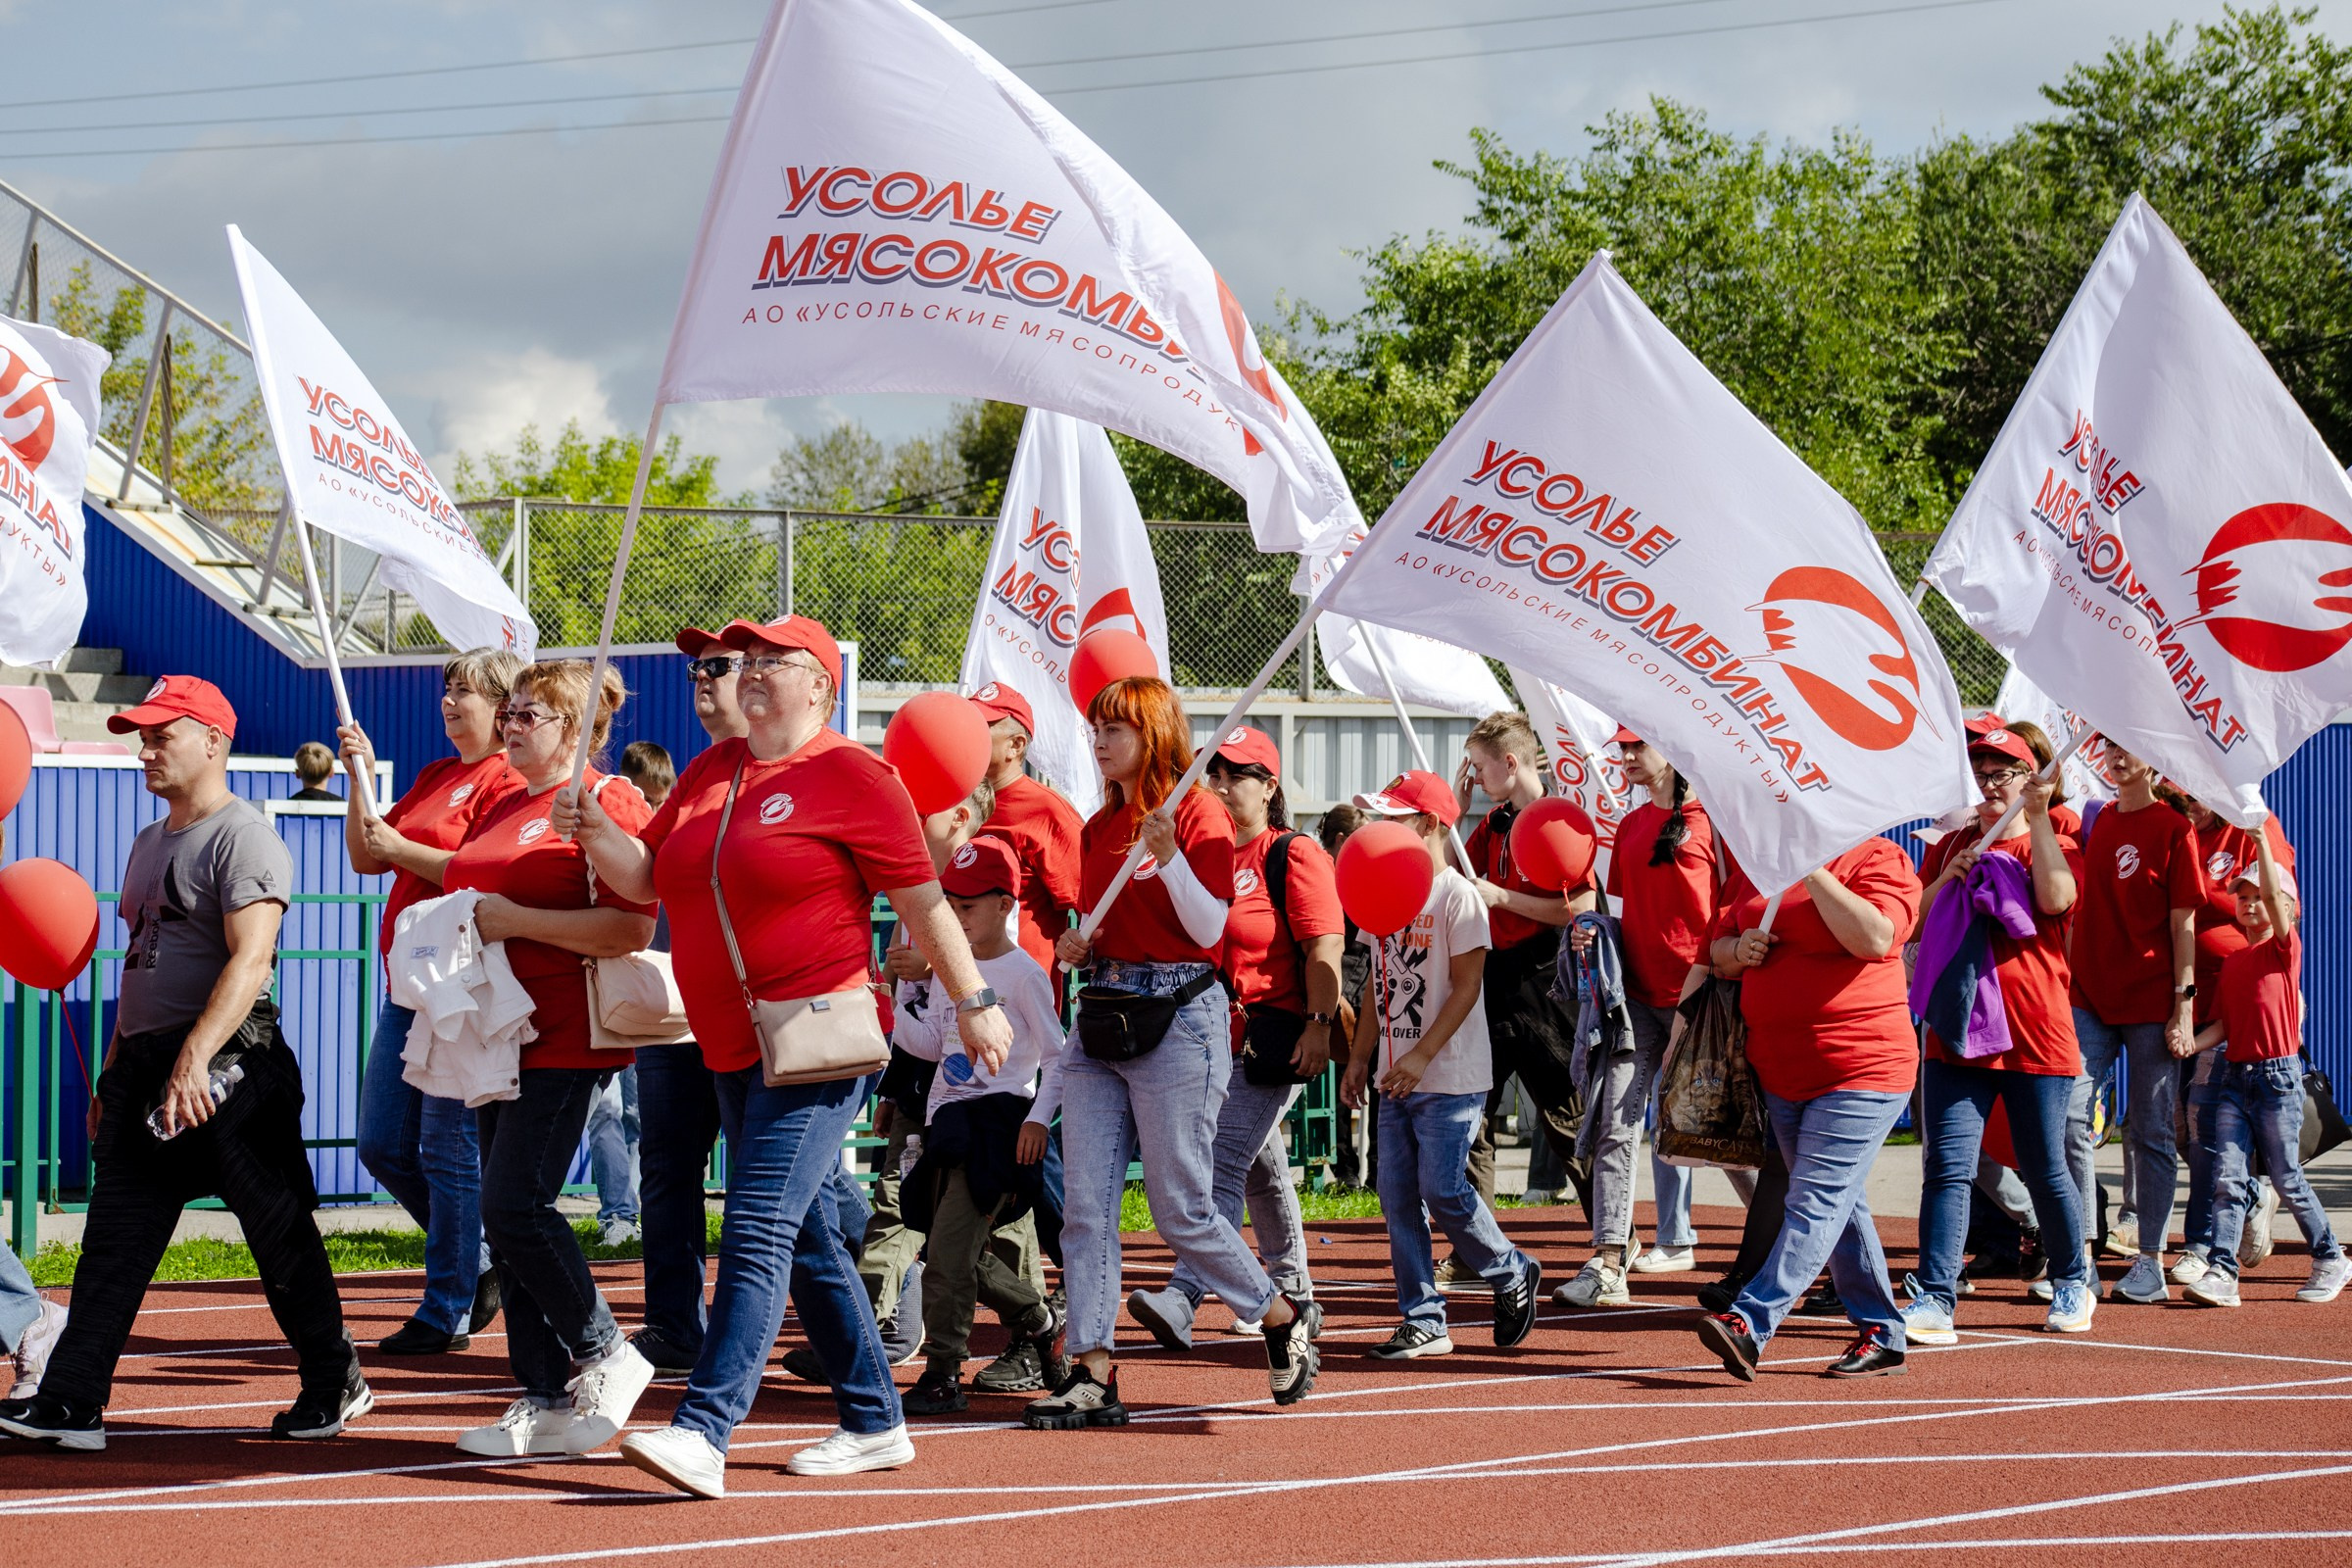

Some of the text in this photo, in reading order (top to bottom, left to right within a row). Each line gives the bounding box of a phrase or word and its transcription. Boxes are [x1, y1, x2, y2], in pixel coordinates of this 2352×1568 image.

[777, 165, 1062, 244] УСОЛЬЕ
[742, 301, 1239, 431] АО «УСОЛЬСКИЕ МЯСОПРОДУК
[295, 374, 438, 490] УСОЛЬЕ
[2058, 408, 2146, 516] УСОЛЬЕ
[318, 472, 342, 492] АО
[1463, 439, 1680, 567] УСОЛЬЕ
[2013, 530, 2038, 553] АО
[1395, 551, 1789, 805] АО «УСОЛЬСКИЕ МЯСОПРОДУКТЫ»
[1415, 495, 1831, 793] МЯСОКОМБИНАТ
[145, 917, 161, 969] Reebok
[1398, 932, 1434, 948] ZONE
[1412, 913, 1435, 929] ED
[1393, 1026, 1422, 1039] OVER
